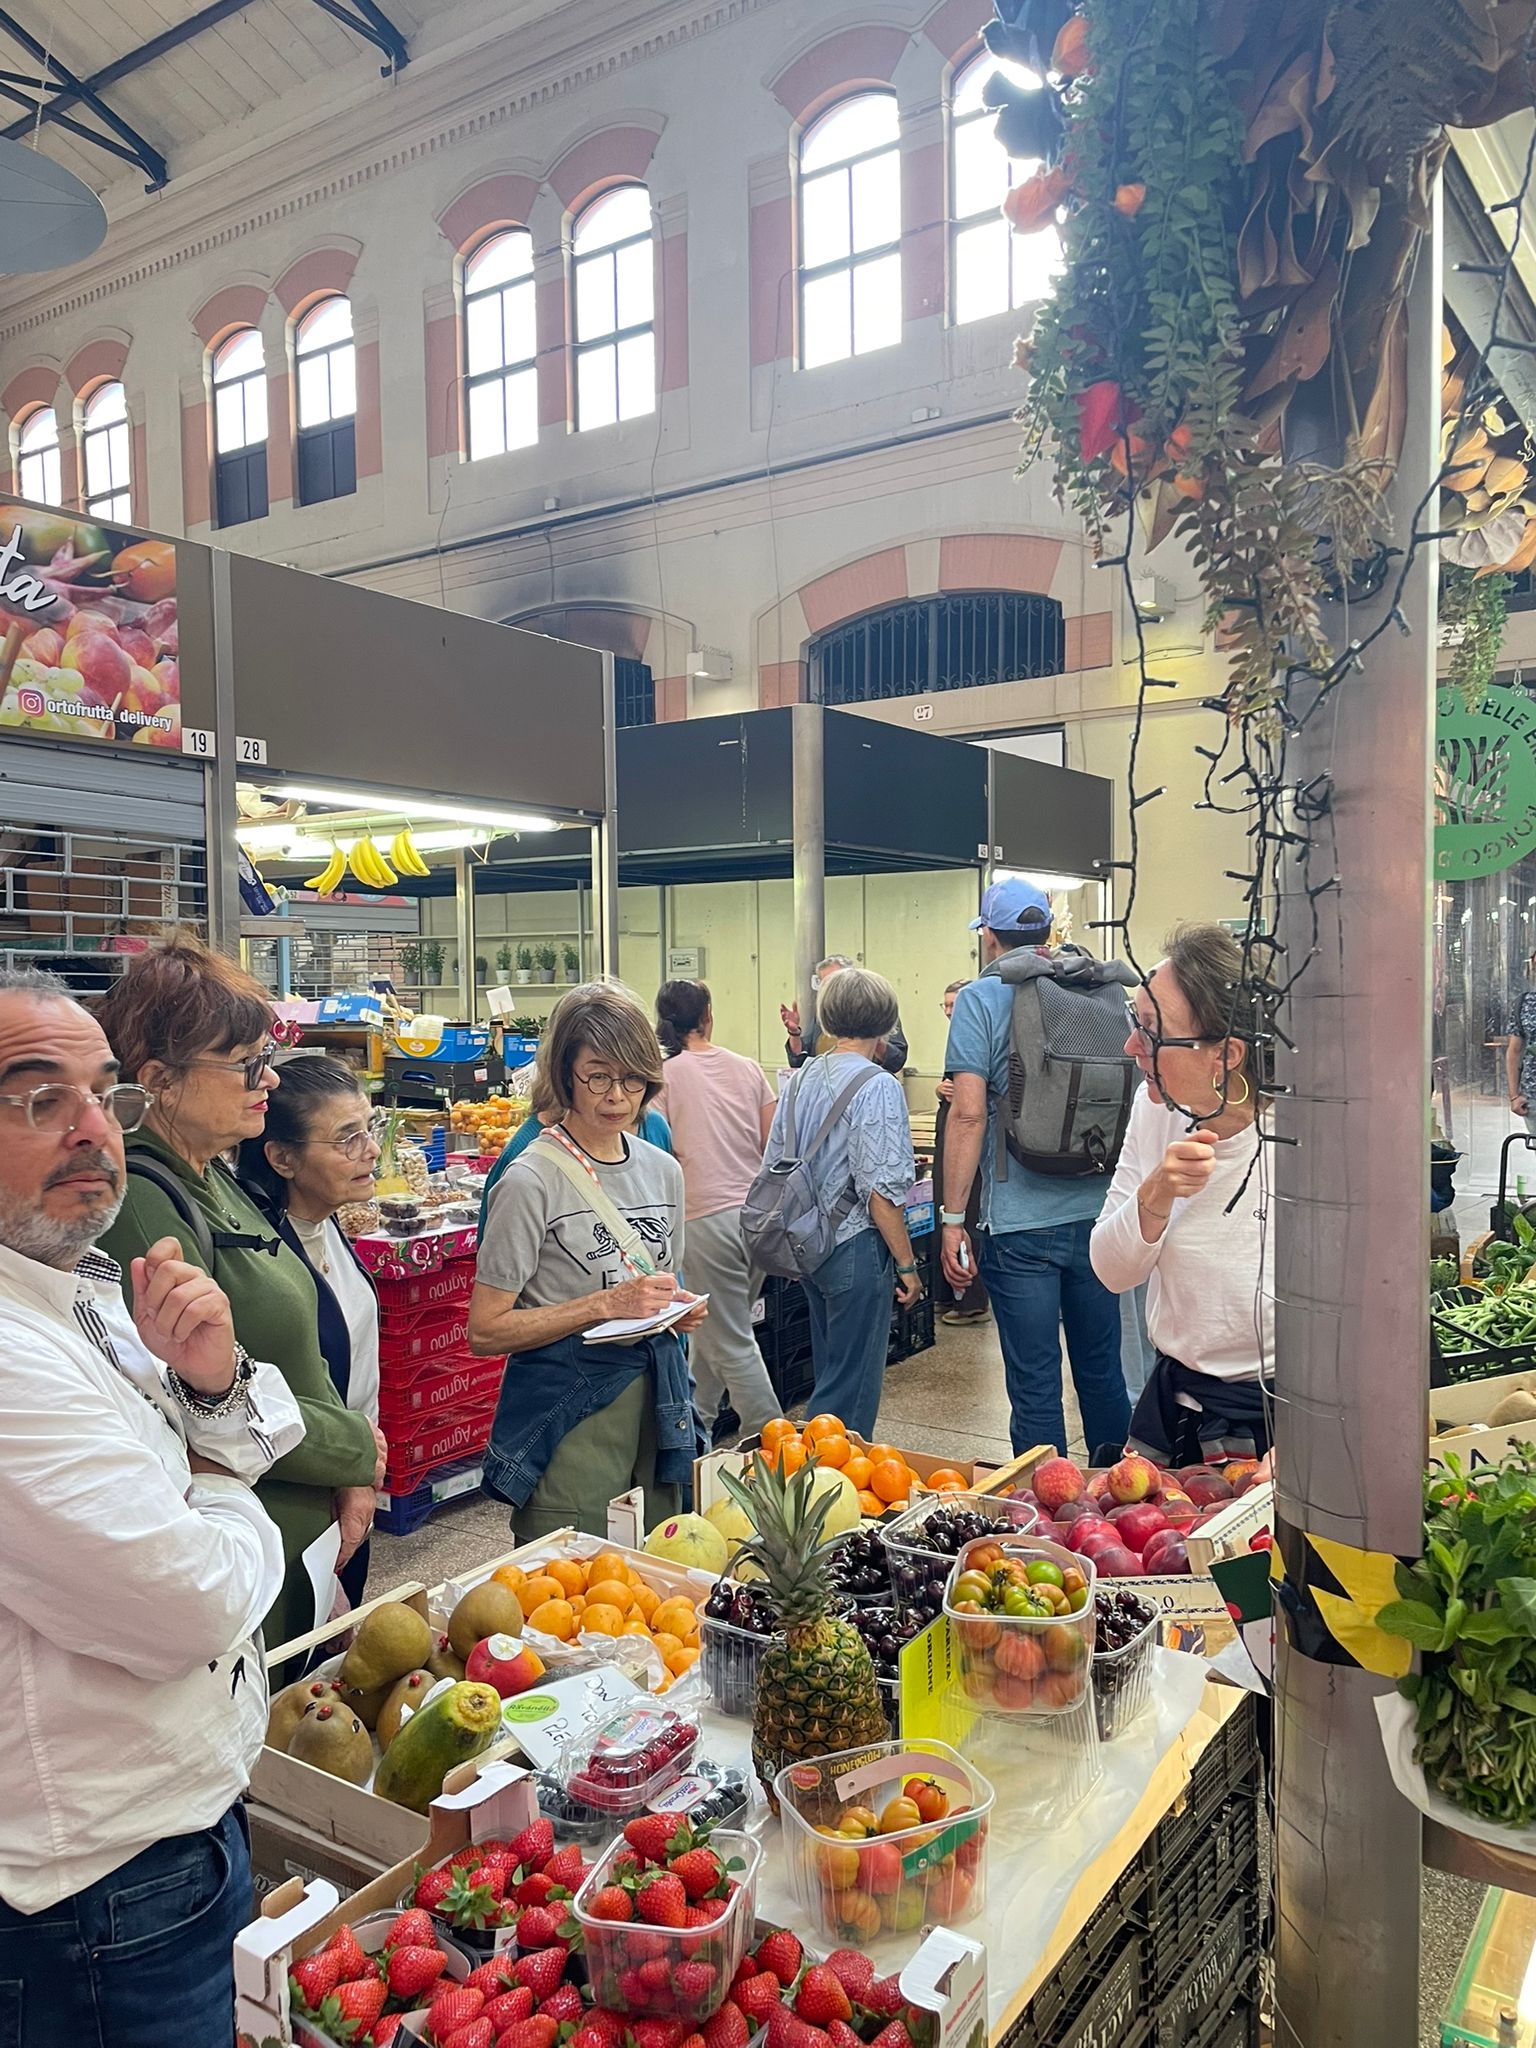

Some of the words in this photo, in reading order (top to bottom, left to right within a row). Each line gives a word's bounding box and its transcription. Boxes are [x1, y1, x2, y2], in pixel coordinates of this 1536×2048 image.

[47, 700, 173, 732] ortofrutta_delivery
[916, 705, 930, 719] 27
[191, 732, 207, 753] 19
[243, 739, 260, 761] 28
